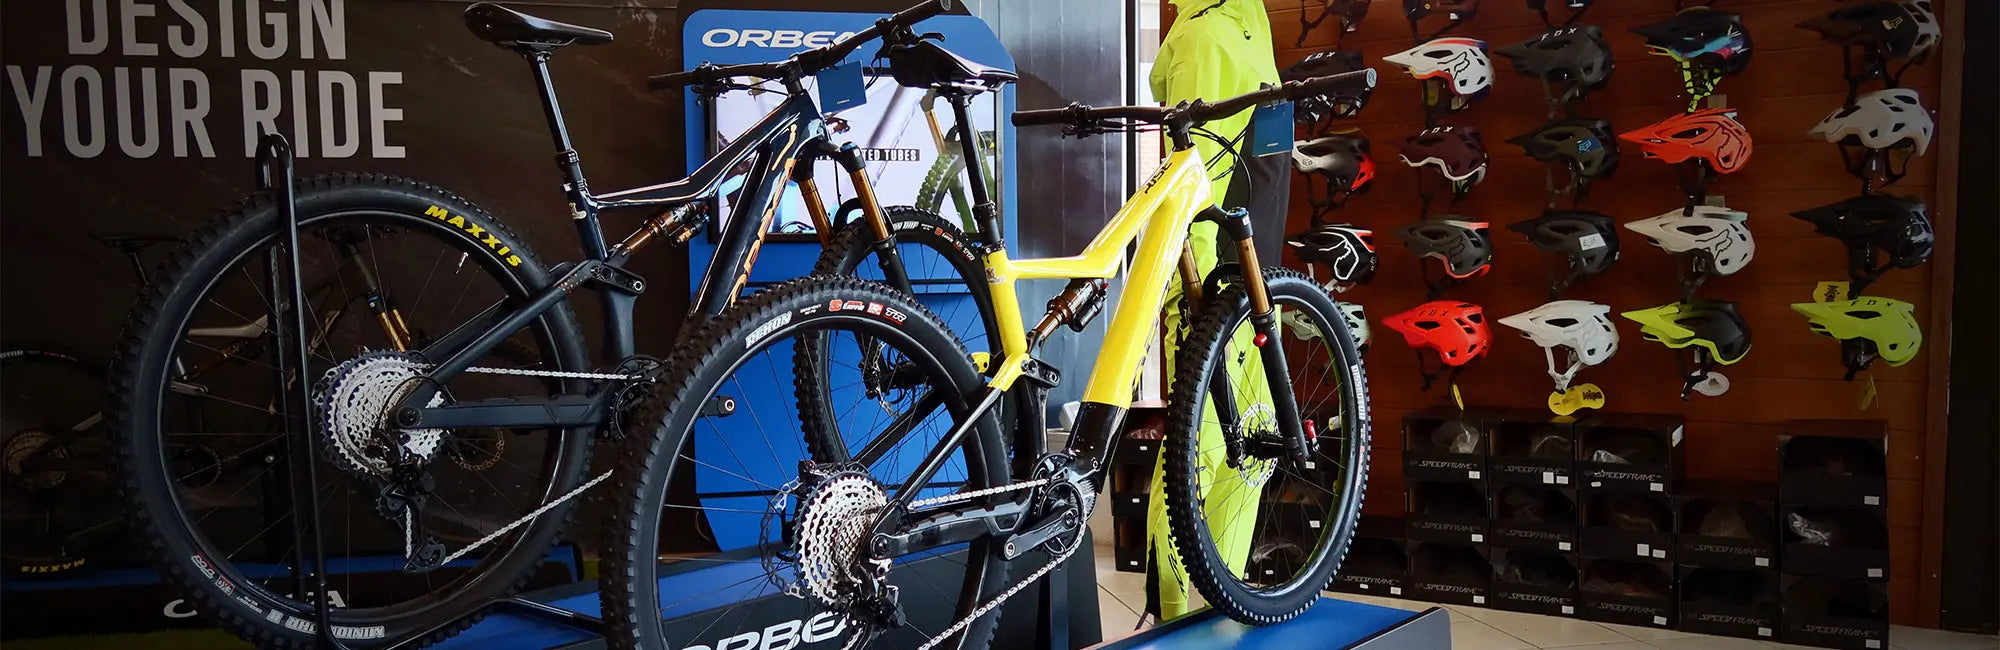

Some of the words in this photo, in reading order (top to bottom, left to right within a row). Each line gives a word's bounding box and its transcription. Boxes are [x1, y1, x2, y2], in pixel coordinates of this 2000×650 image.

[65, 0, 347, 60] DESIGN
[1541, 28, 1577, 41] FOX
[1304, 51, 1336, 62] FOX
[6, 65, 217, 158] YOUR
[240, 69, 407, 158] RIDE
[1420, 126, 1453, 136] FOX
[884, 149, 917, 161] TUBES
[424, 205, 522, 267] MAXXIS
